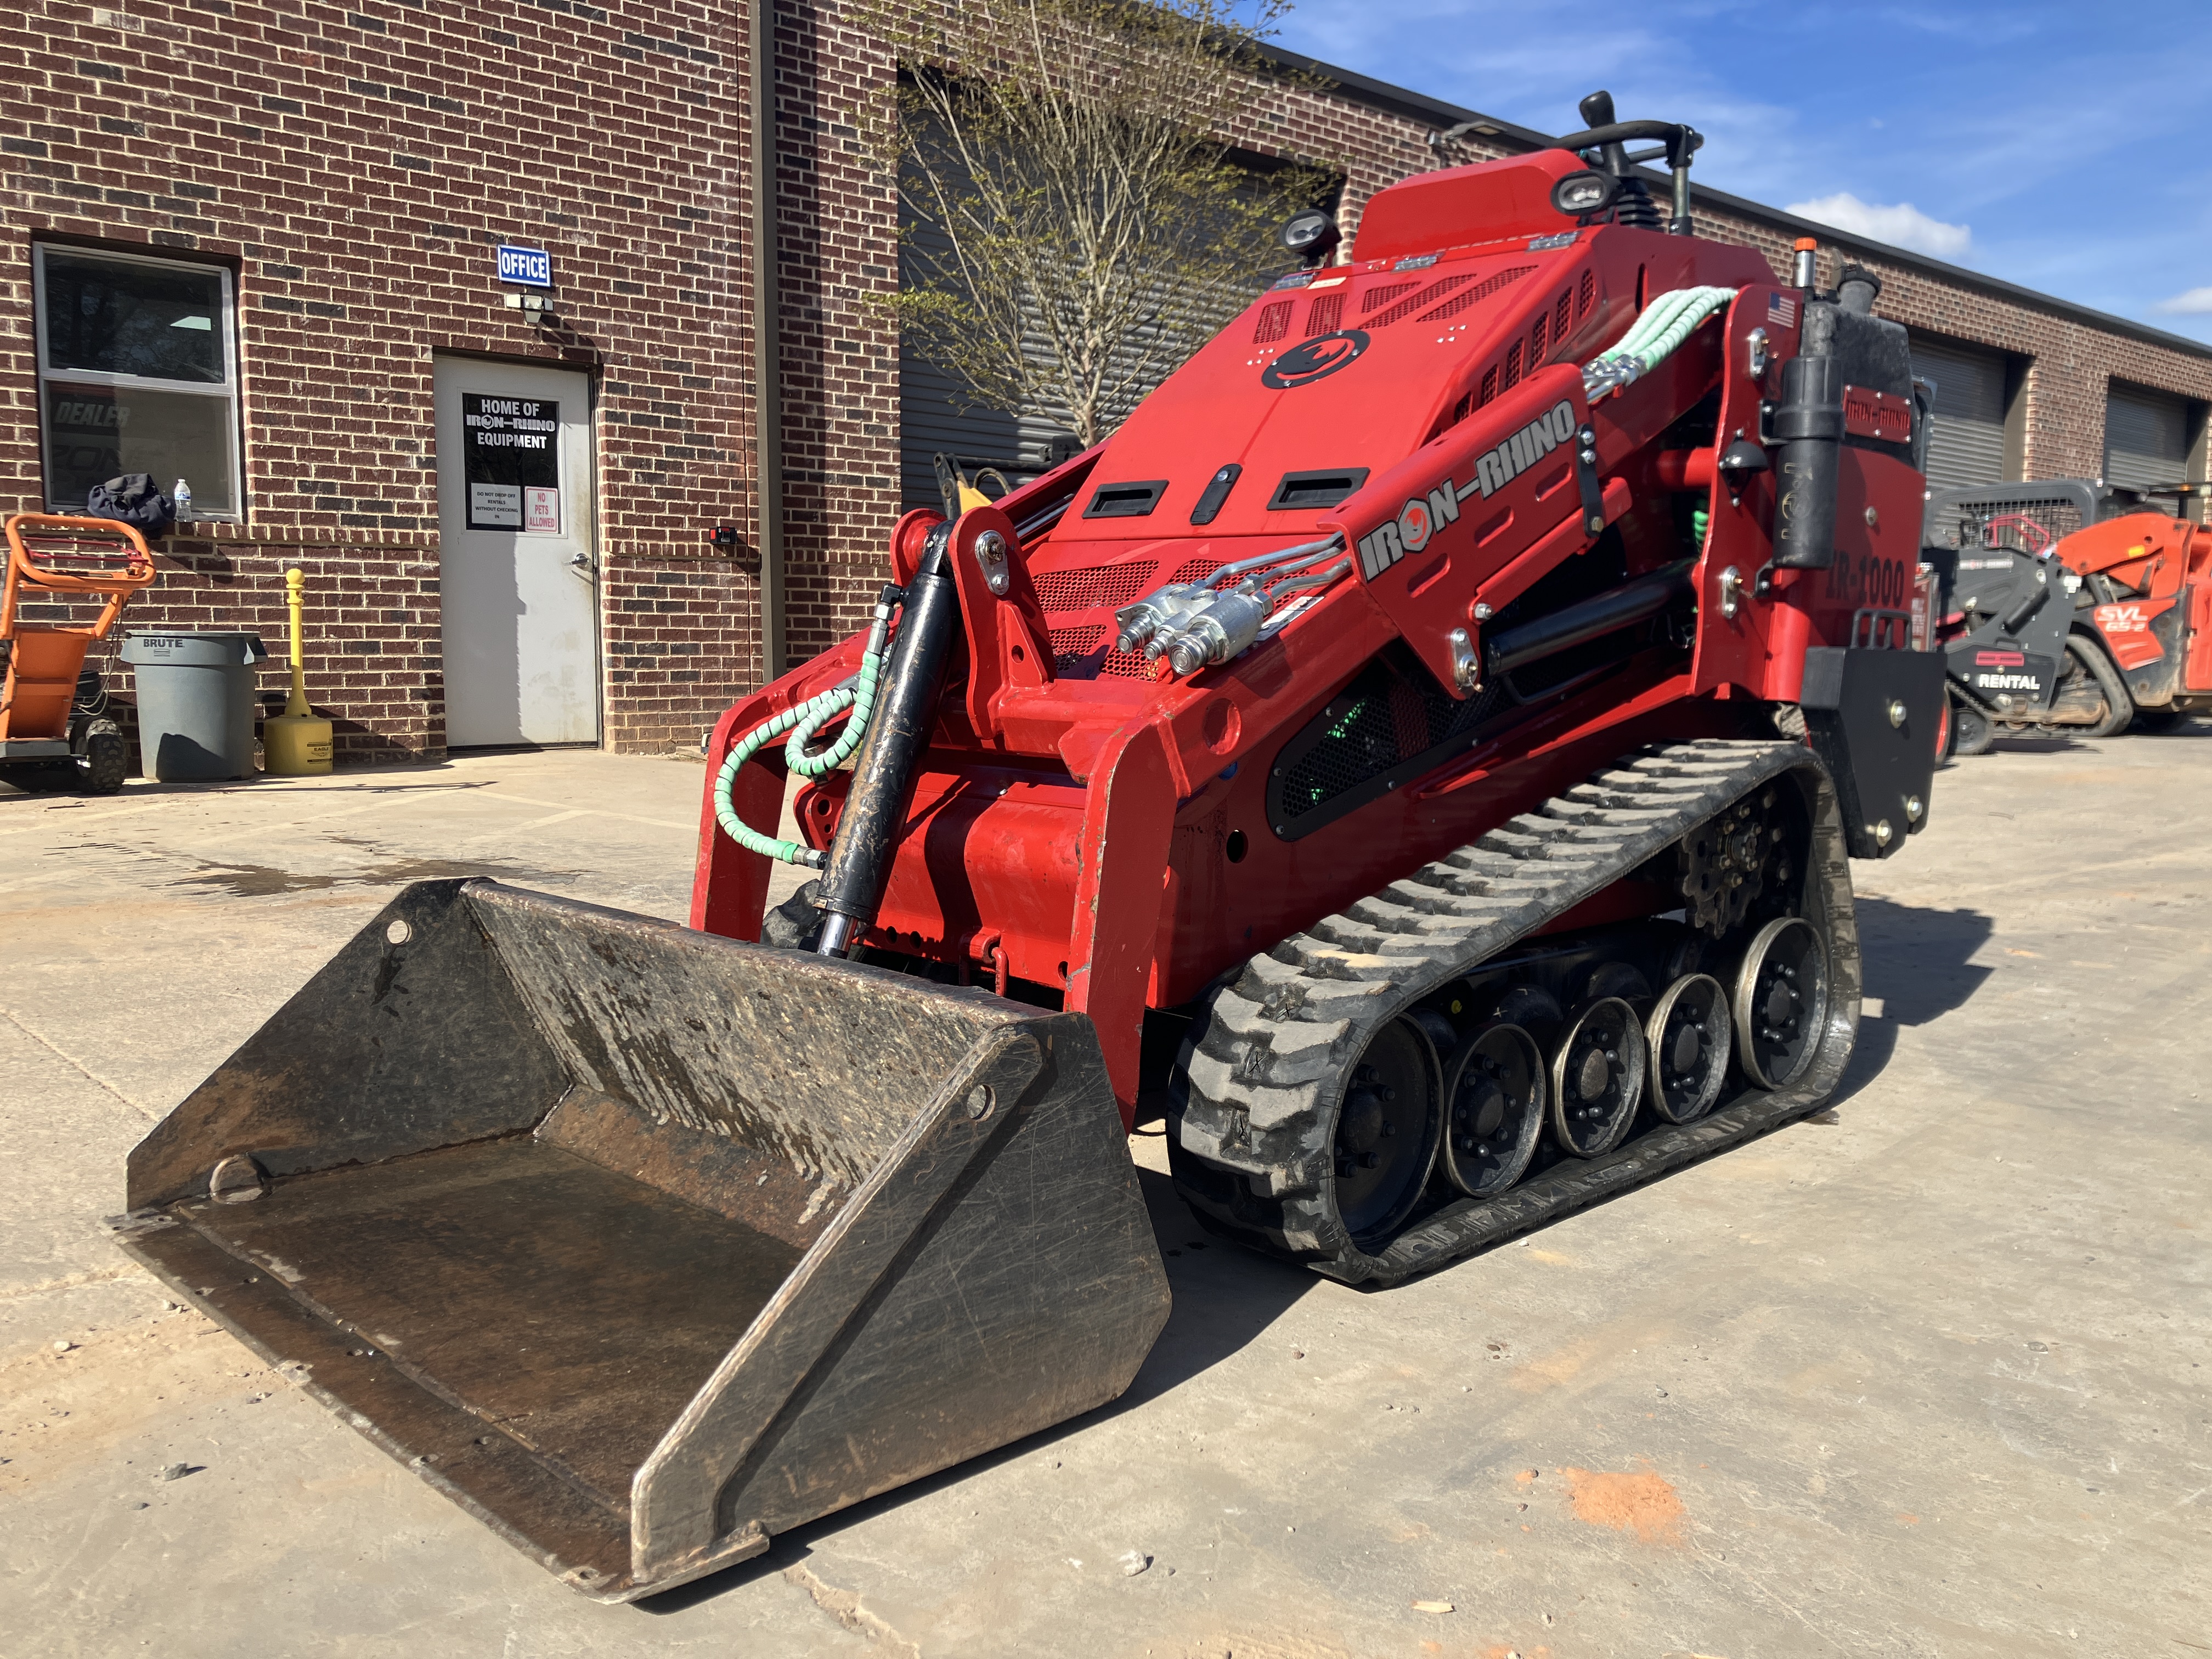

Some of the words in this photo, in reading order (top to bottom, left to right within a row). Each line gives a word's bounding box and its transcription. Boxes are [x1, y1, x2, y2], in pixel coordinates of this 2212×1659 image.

[501, 252, 546, 279] OFFICE
[55, 402, 131, 428] DEALER
[481, 399, 520, 415] HOME
[523, 402, 540, 416] OF
[466, 414, 556, 432] IRON-RHINO
[477, 432, 547, 449] EQUIPMENT
[538, 492, 546, 503] NO
[1357, 399, 1577, 583] IRON-RHINO
[535, 505, 549, 515] PETS
[529, 517, 555, 528] ALLOWED
[2097, 606, 2148, 621] SVL
[2106, 621, 2146, 633] 65-2
[144, 639, 183, 648] BRUTE
[1979, 674, 2040, 690] RENTAL
